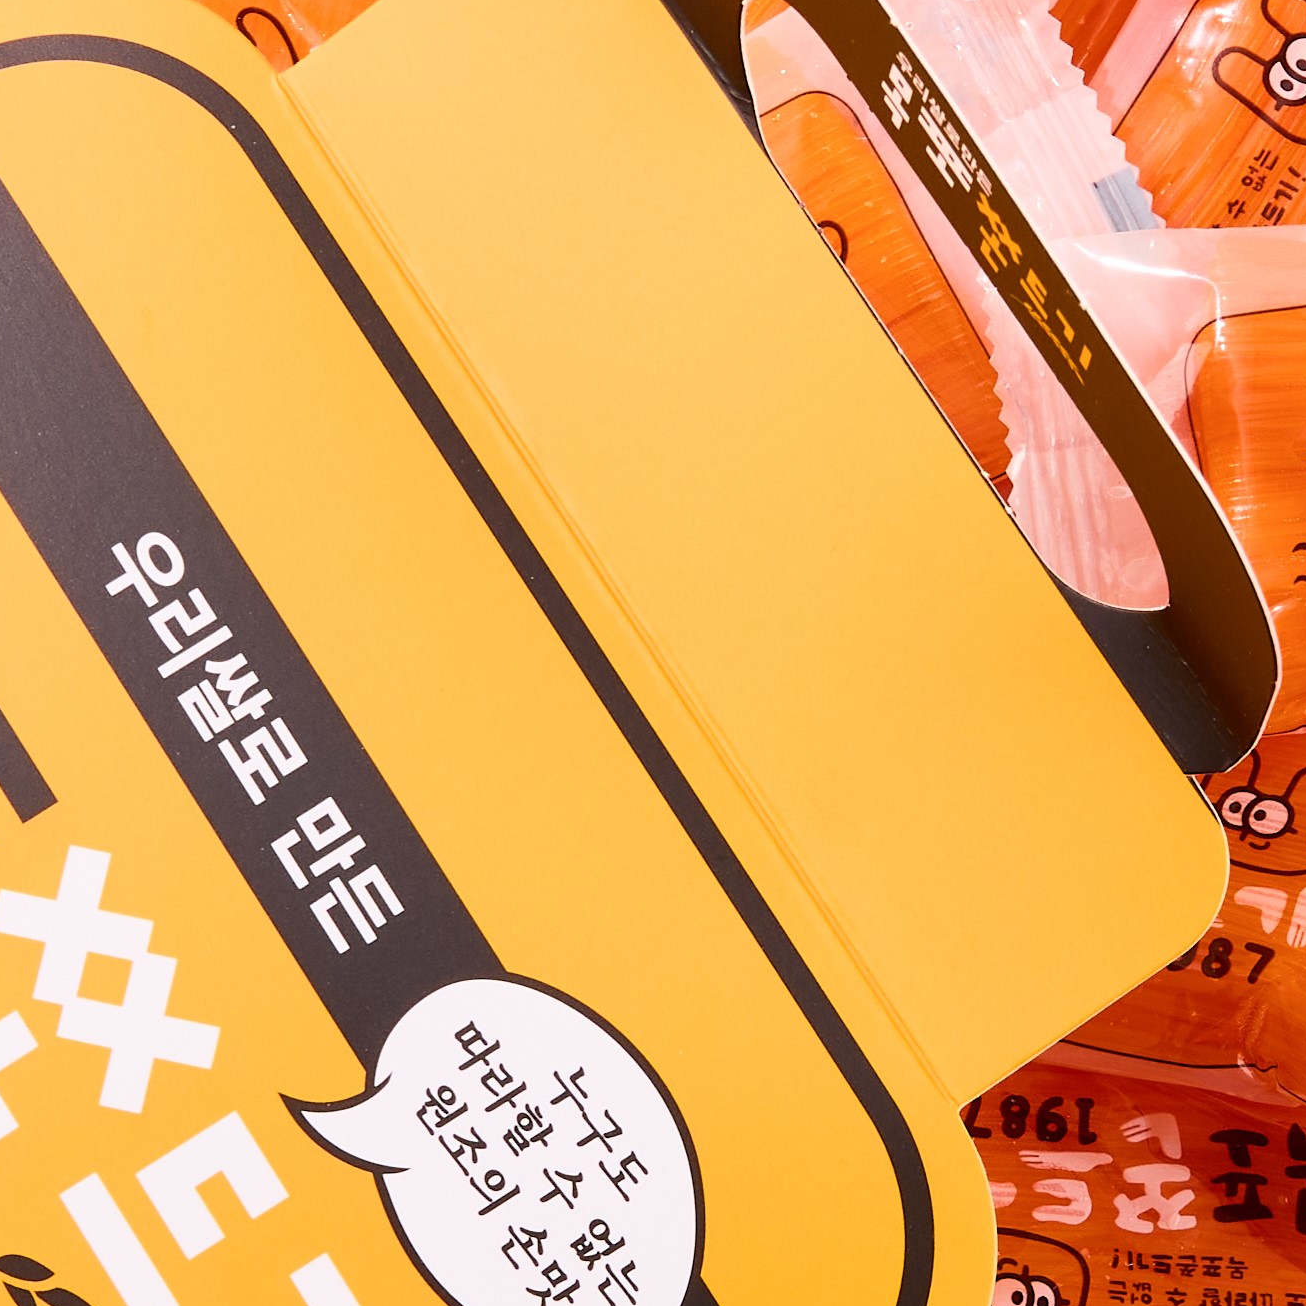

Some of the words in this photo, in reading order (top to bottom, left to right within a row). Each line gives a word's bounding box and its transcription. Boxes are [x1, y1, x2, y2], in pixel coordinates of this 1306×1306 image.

[1226, 197, 1247, 221] 수
[1241, 146, 1280, 194] 없는
[104, 530, 310, 807] 우리쌀로
[269, 795, 407, 956] 만든
[415, 1084, 521, 1217] 원조의
[453, 1020, 555, 1157] 따라할
[540, 1167, 584, 1210] 수
[549, 1065, 650, 1203] 누구도
[964, 1094, 1098, 1145] 1987
[1107, 1279, 1153, 1306] 없는
